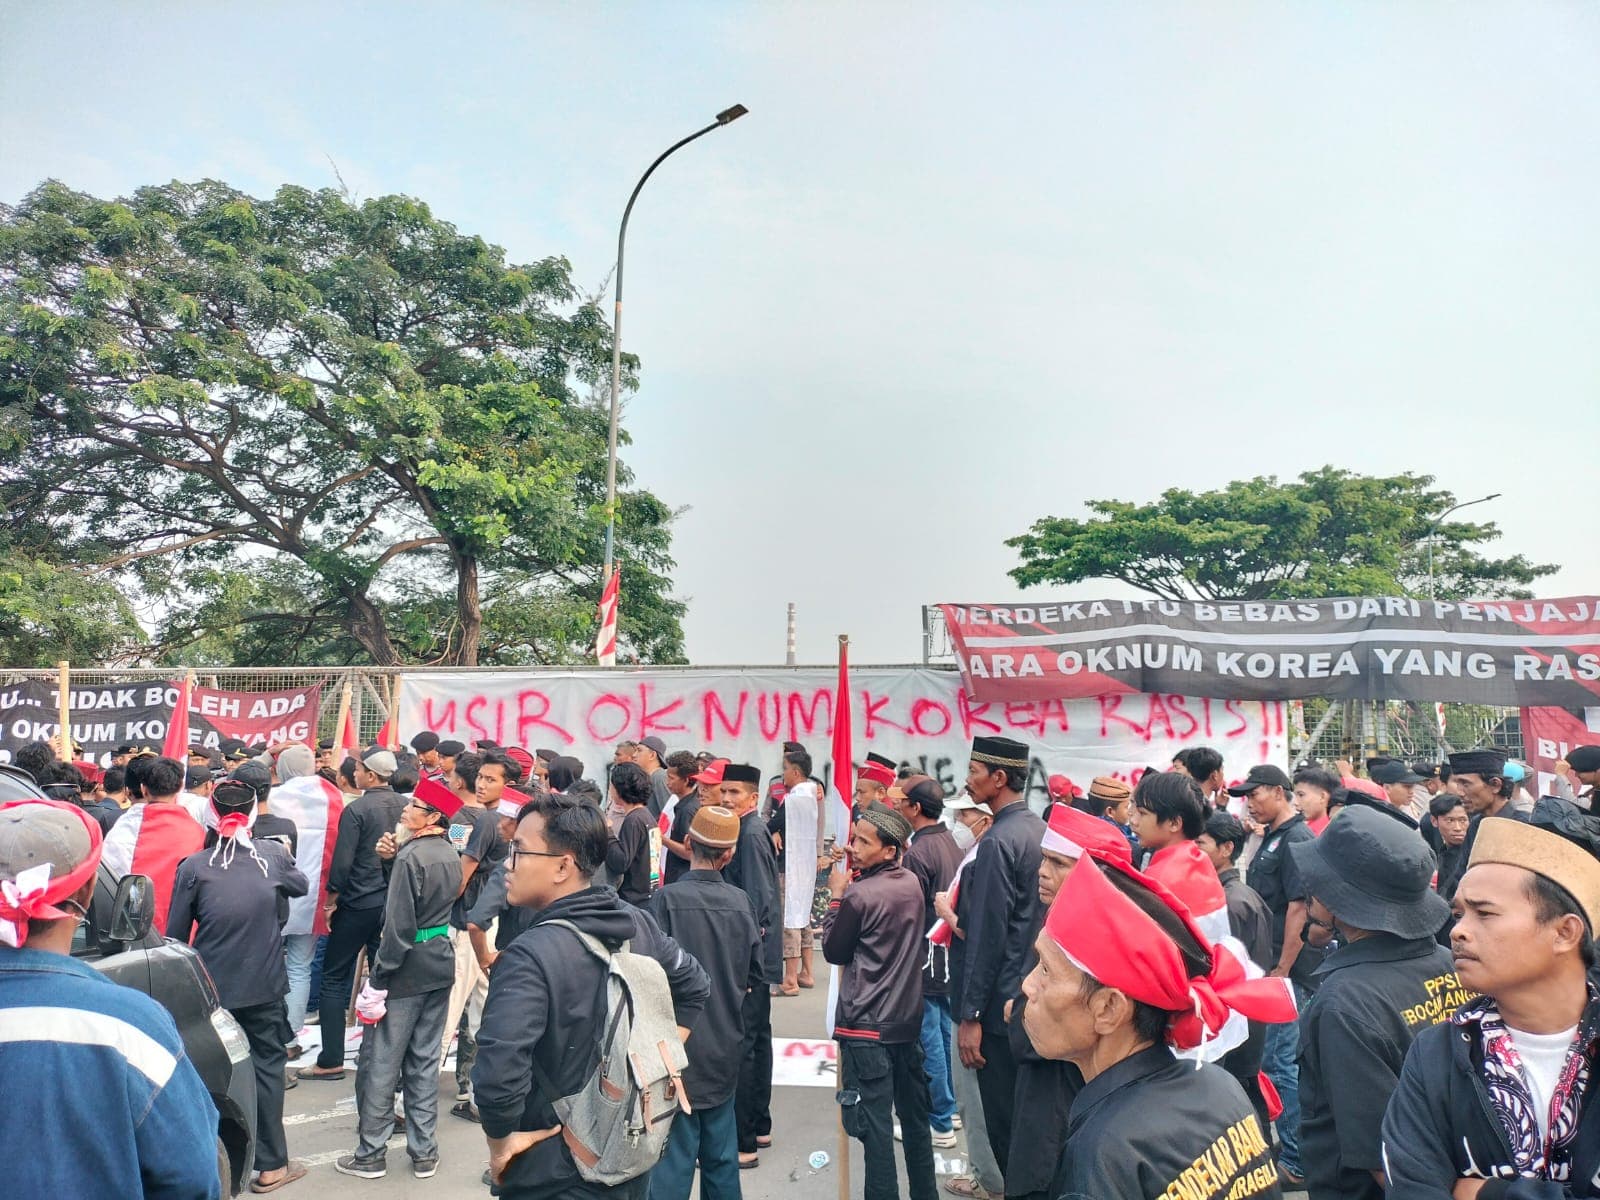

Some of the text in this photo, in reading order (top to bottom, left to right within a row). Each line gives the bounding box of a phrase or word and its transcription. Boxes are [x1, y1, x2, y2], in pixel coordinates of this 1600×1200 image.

[1194, 602, 1321, 622] BEBAS
[1333, 598, 1421, 620] DARI
[1434, 601, 1600, 623] PENJAJ
[969, 653, 1045, 679] ARA
[1057, 643, 1203, 675] OKNUM
[1216, 651, 1361, 679] KOREA
[1373, 648, 1497, 679] YANG
[51, 688, 137, 709] TIDAK
[145, 687, 240, 718] BOLEH
[248, 693, 306, 719] ADA
[424, 688, 574, 748] USIR
[125, 720, 221, 750] KOEA
